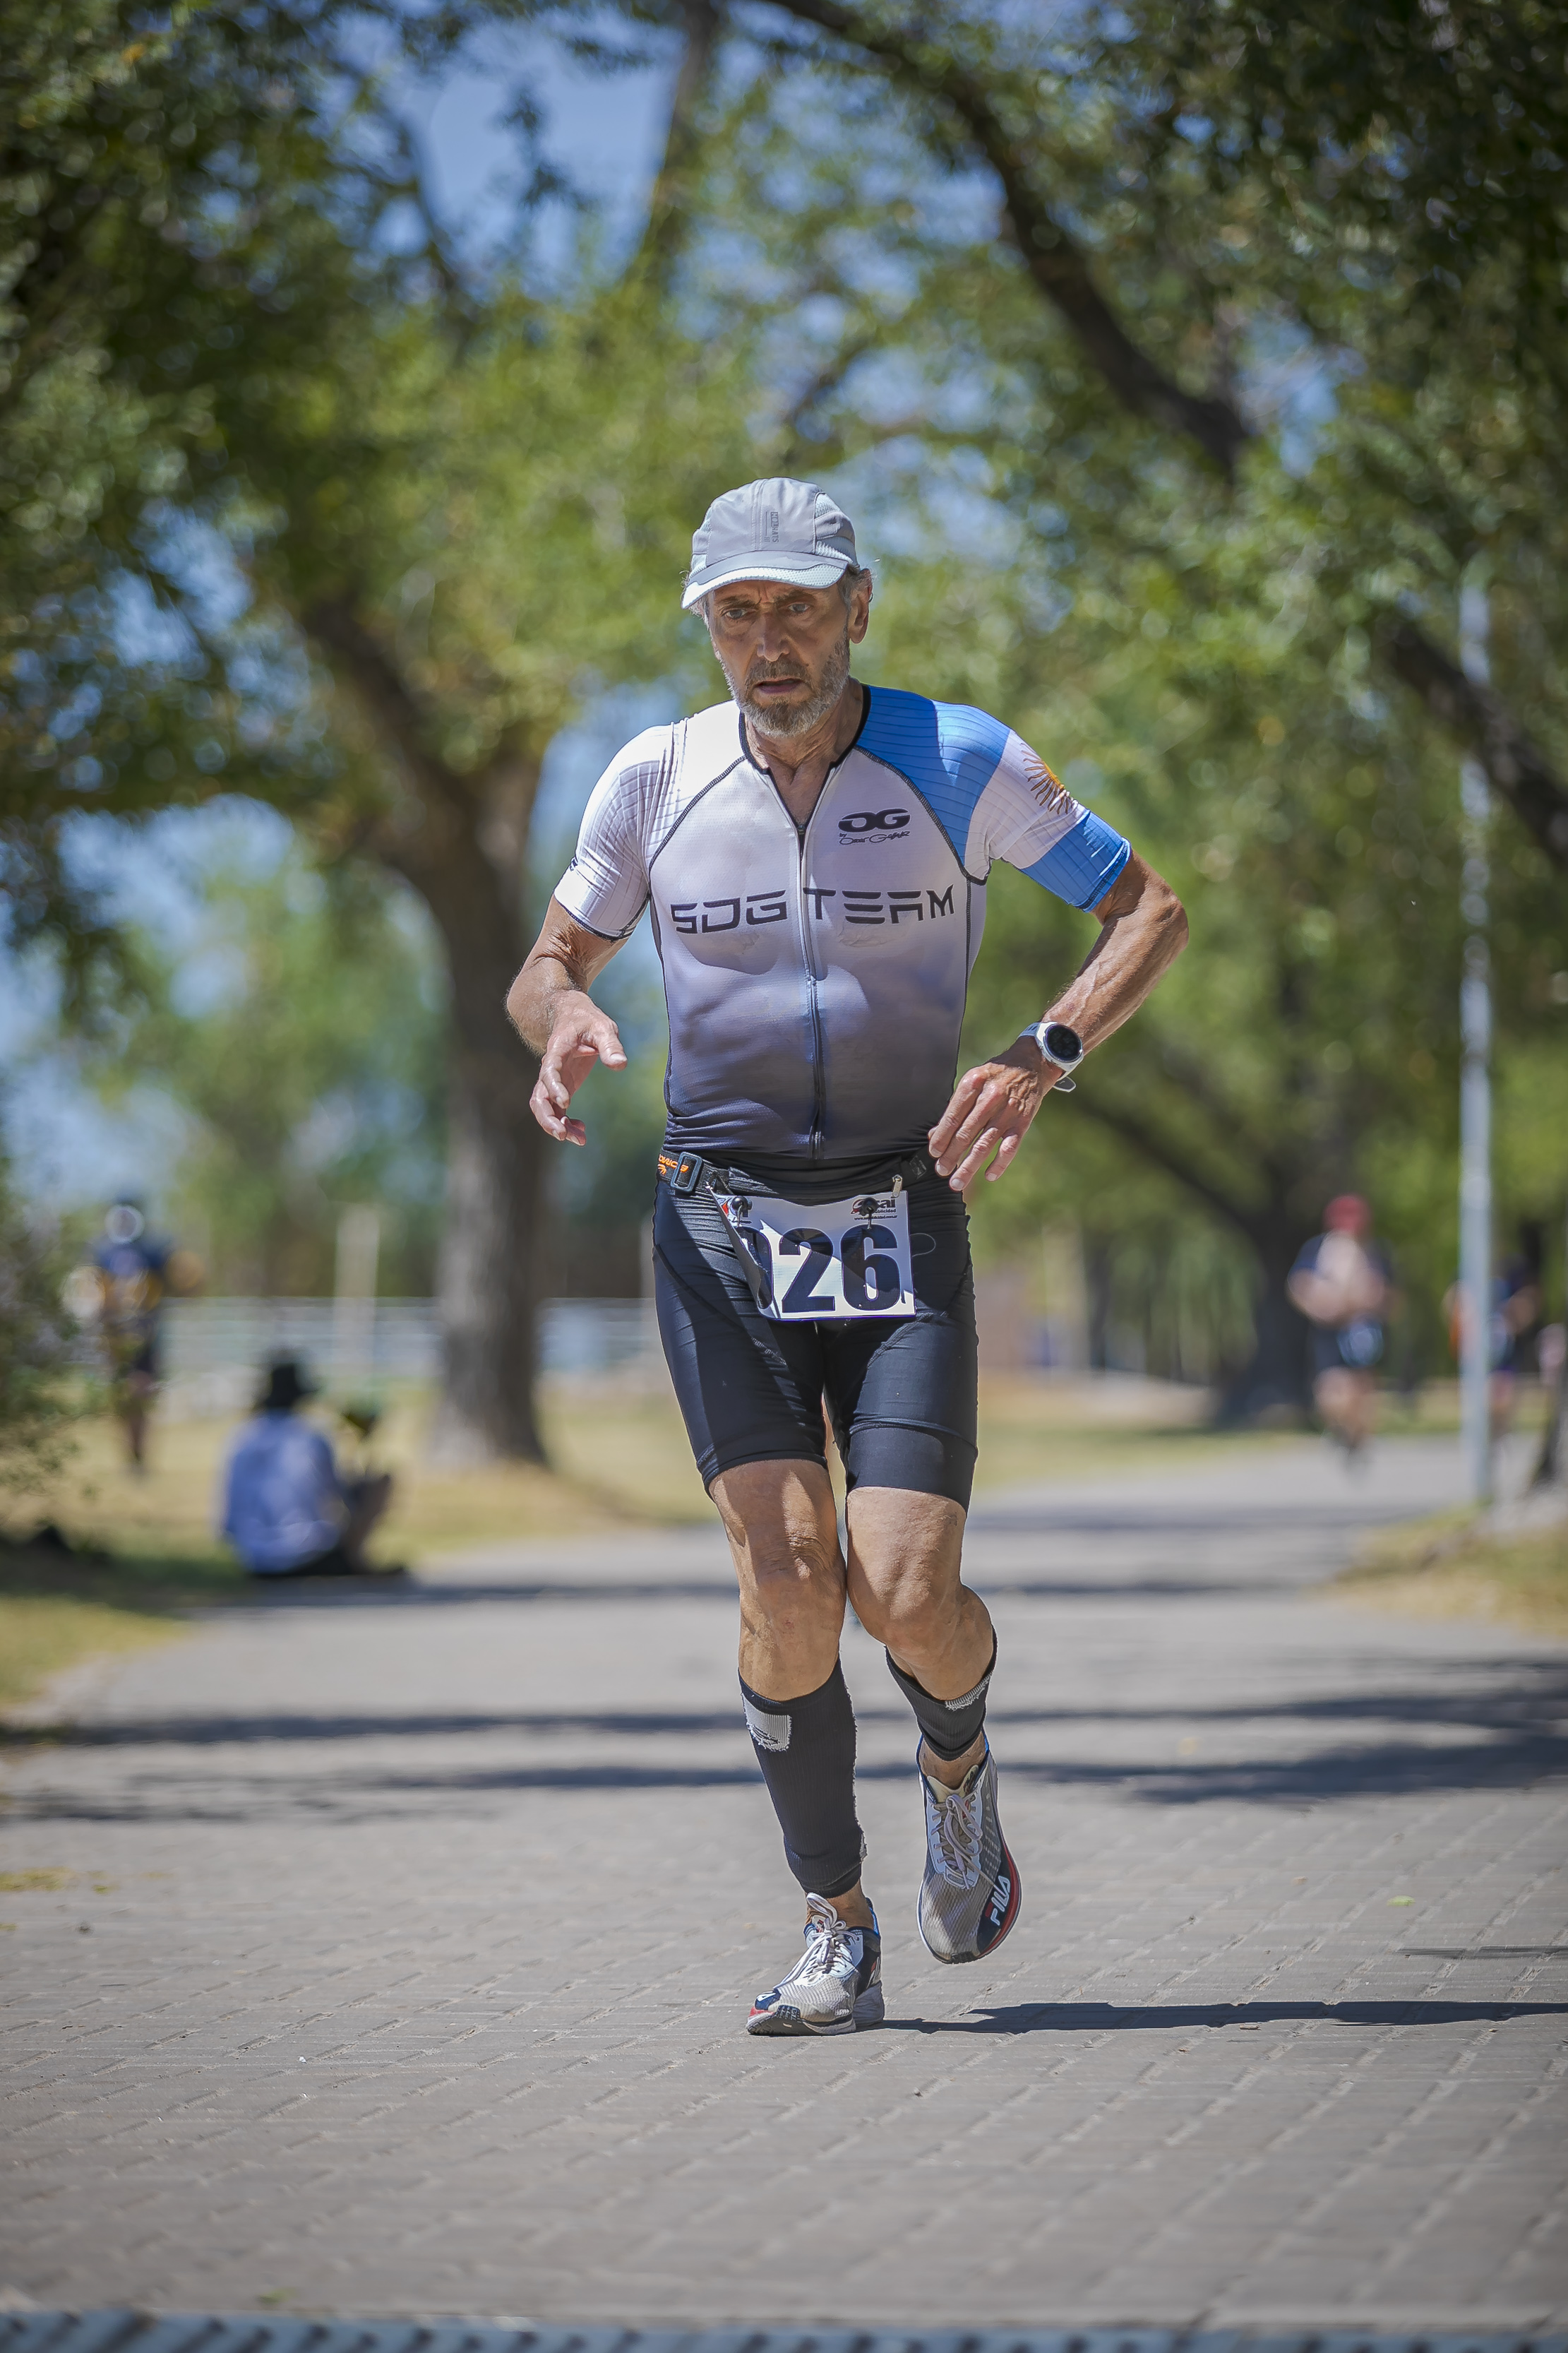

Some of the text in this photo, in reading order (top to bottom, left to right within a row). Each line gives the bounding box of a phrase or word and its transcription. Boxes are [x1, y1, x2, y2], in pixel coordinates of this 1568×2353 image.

[838, 808, 911, 833] OG
[803, 884, 954, 924] TEAM
[985, 1876, 1010, 1926] FILA
